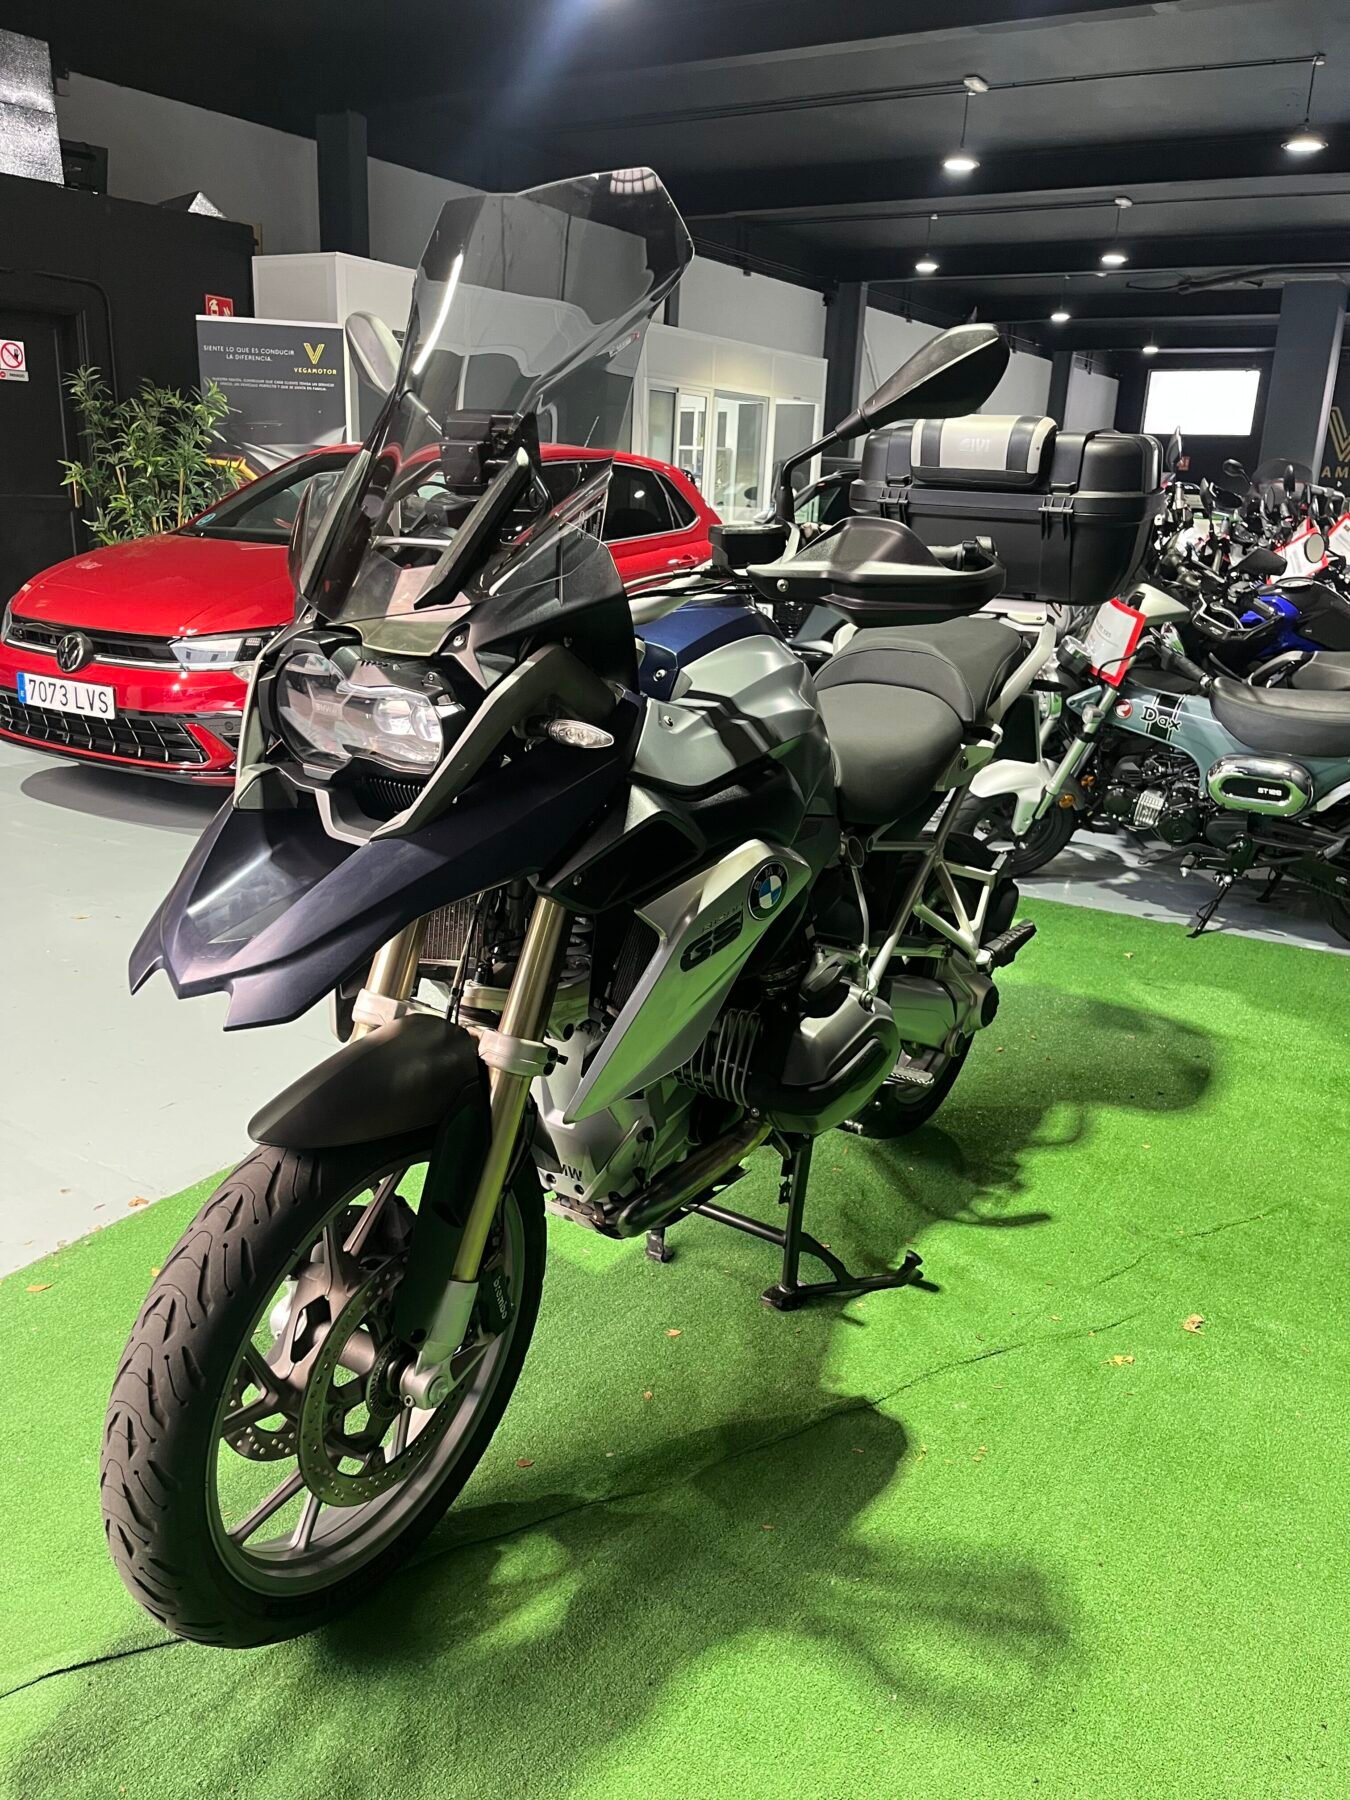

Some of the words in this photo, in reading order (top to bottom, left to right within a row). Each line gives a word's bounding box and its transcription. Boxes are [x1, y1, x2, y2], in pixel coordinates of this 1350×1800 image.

[203, 344, 224, 352] SIENTE
[236, 346, 249, 354] QUE
[260, 348, 295, 356] CONDUCIR
[293, 367, 337, 375] VEGAMOTOR
[959, 438, 991, 453] GIVI
[29, 679, 69, 706] 7073
[74, 687, 109, 714] LVS
[1140, 706, 1182, 732] Dax
[680, 910, 743, 972] GS
[561, 1164, 583, 1182] MW
